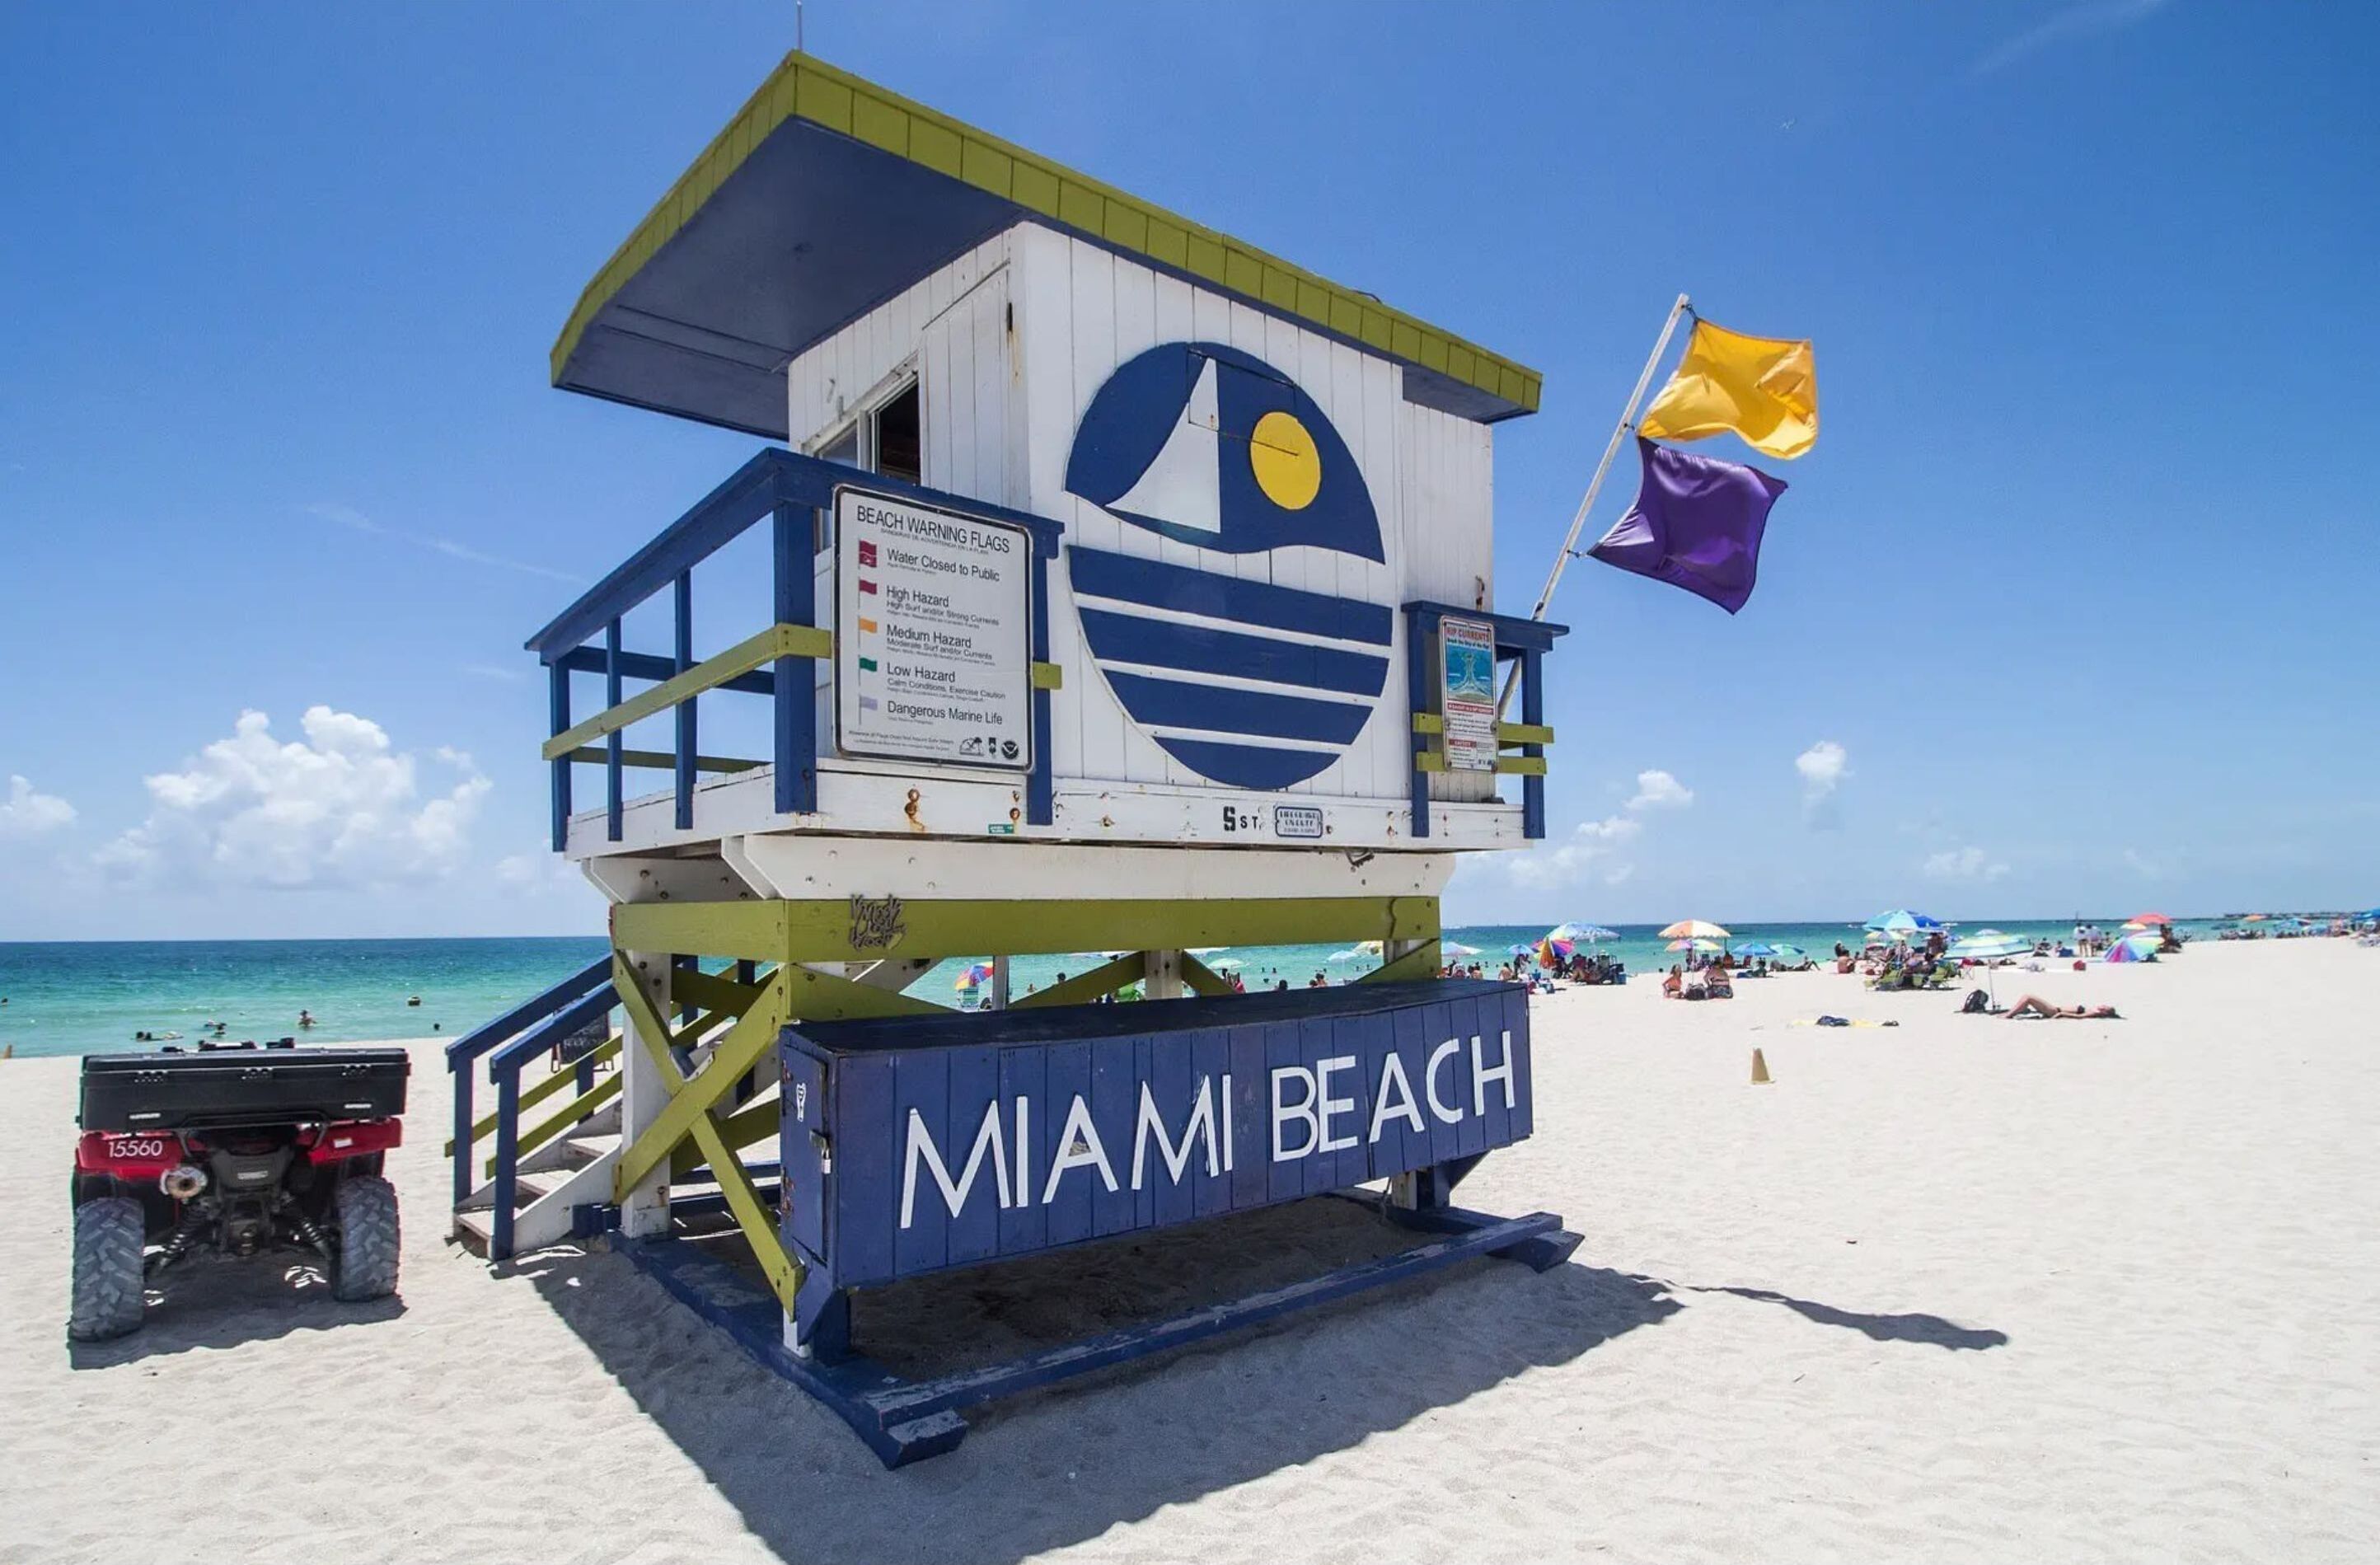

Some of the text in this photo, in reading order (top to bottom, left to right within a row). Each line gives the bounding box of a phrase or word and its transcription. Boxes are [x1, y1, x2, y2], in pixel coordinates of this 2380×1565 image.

[857, 505, 1010, 553] BEACH WARNING FLAGS
[888, 548, 918, 565] Water
[921, 555, 957, 573] Closed
[959, 565, 969, 575] to
[972, 565, 1000, 582] Public
[887, 585, 949, 607] High Hazard
[887, 600, 903, 611] High
[905, 603, 921, 613] Surf
[947, 611, 970, 622] Strong
[971, 614, 1000, 626] Currents
[887, 624, 972, 649] Medium Hazard
[924, 643, 939, 652] Surf
[963, 649, 992, 660] Currents
[887, 662, 955, 683] Low Hazard
[980, 689, 1006, 700] Caution
[888, 701, 945, 719] Dangerous
[949, 708, 983, 723] Marine
[985, 712, 1003, 725] Life
[900, 1030, 1516, 1230] MIAMI BEACH
[108, 1140, 163, 1158] 15560
